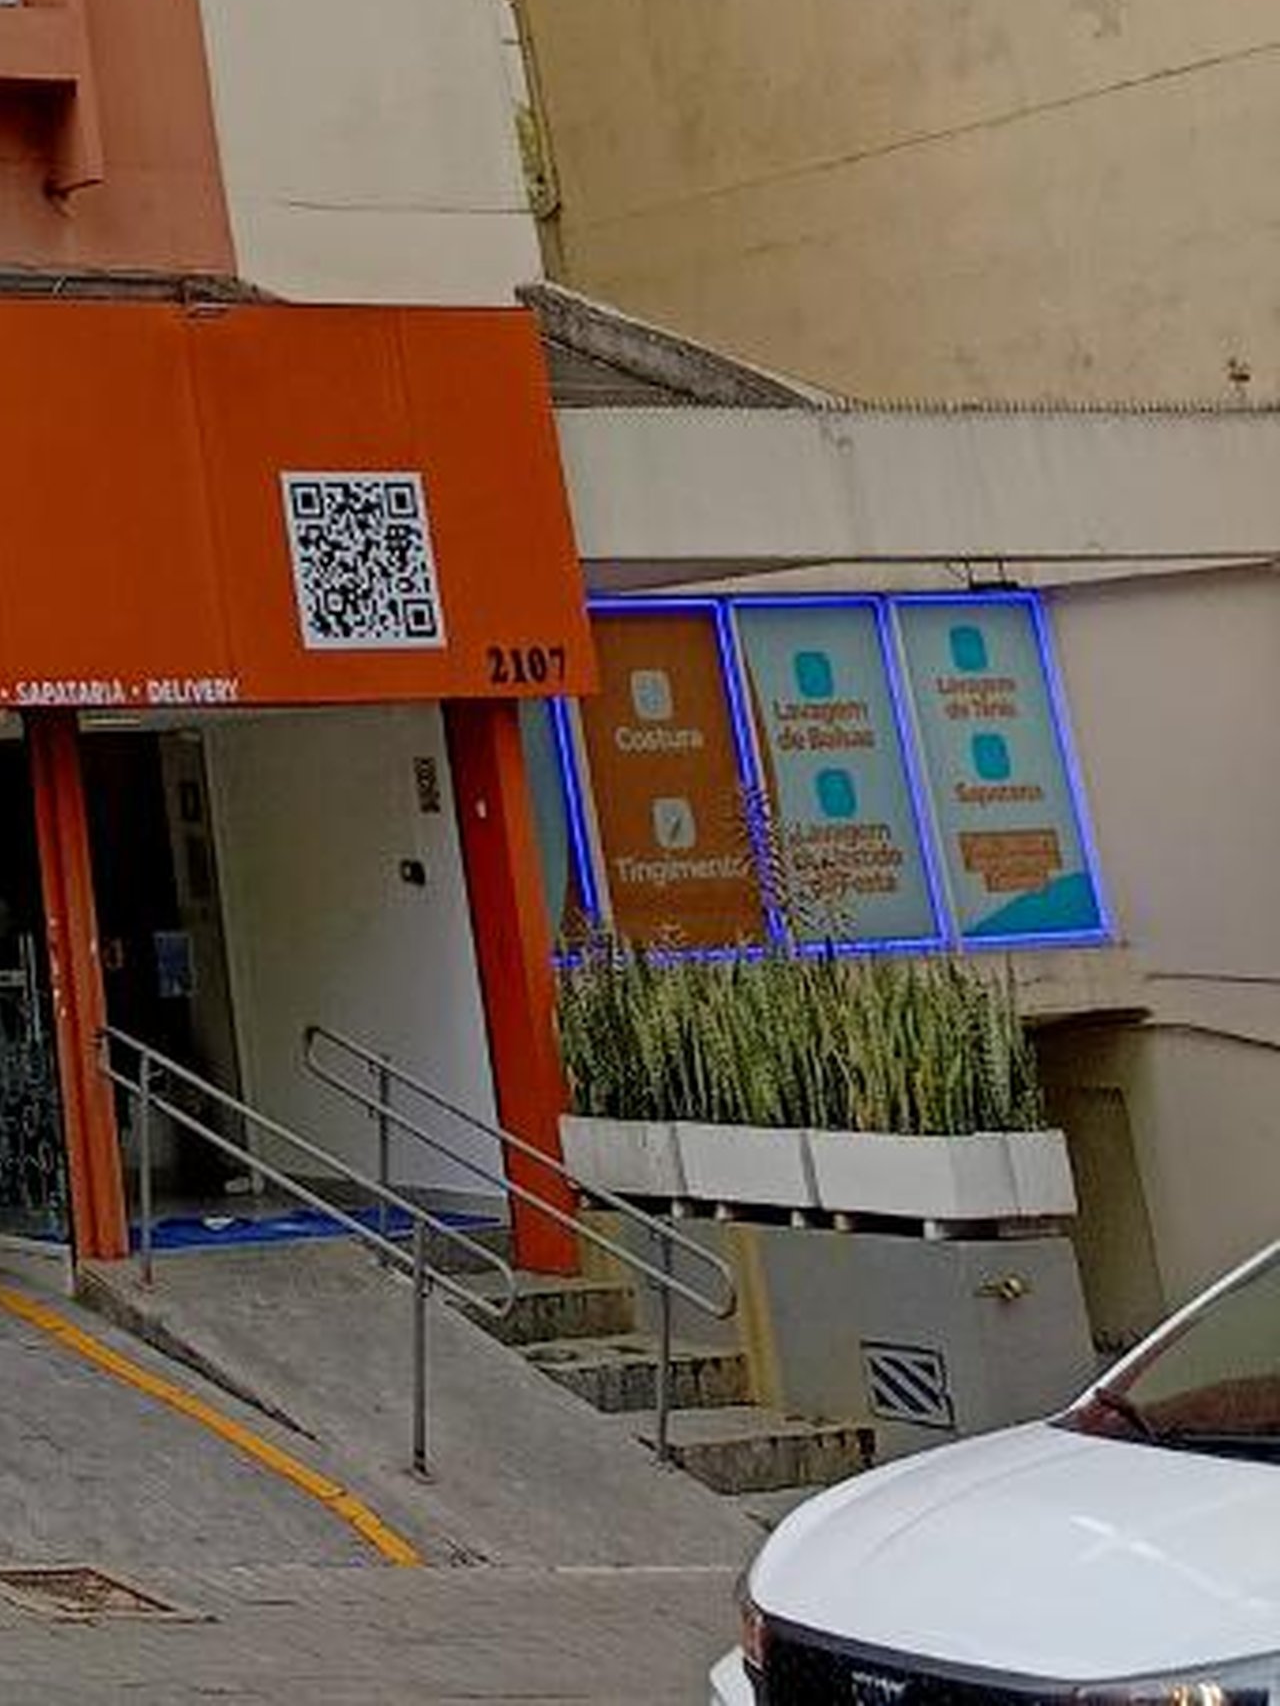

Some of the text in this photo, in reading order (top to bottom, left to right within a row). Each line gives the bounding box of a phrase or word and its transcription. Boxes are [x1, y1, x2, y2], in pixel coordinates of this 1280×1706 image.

[486, 646, 565, 684] 2107
[14, 679, 126, 705] SAPATARIA
[147, 677, 240, 703] DELIVERY
[615, 725, 704, 752] Costura
